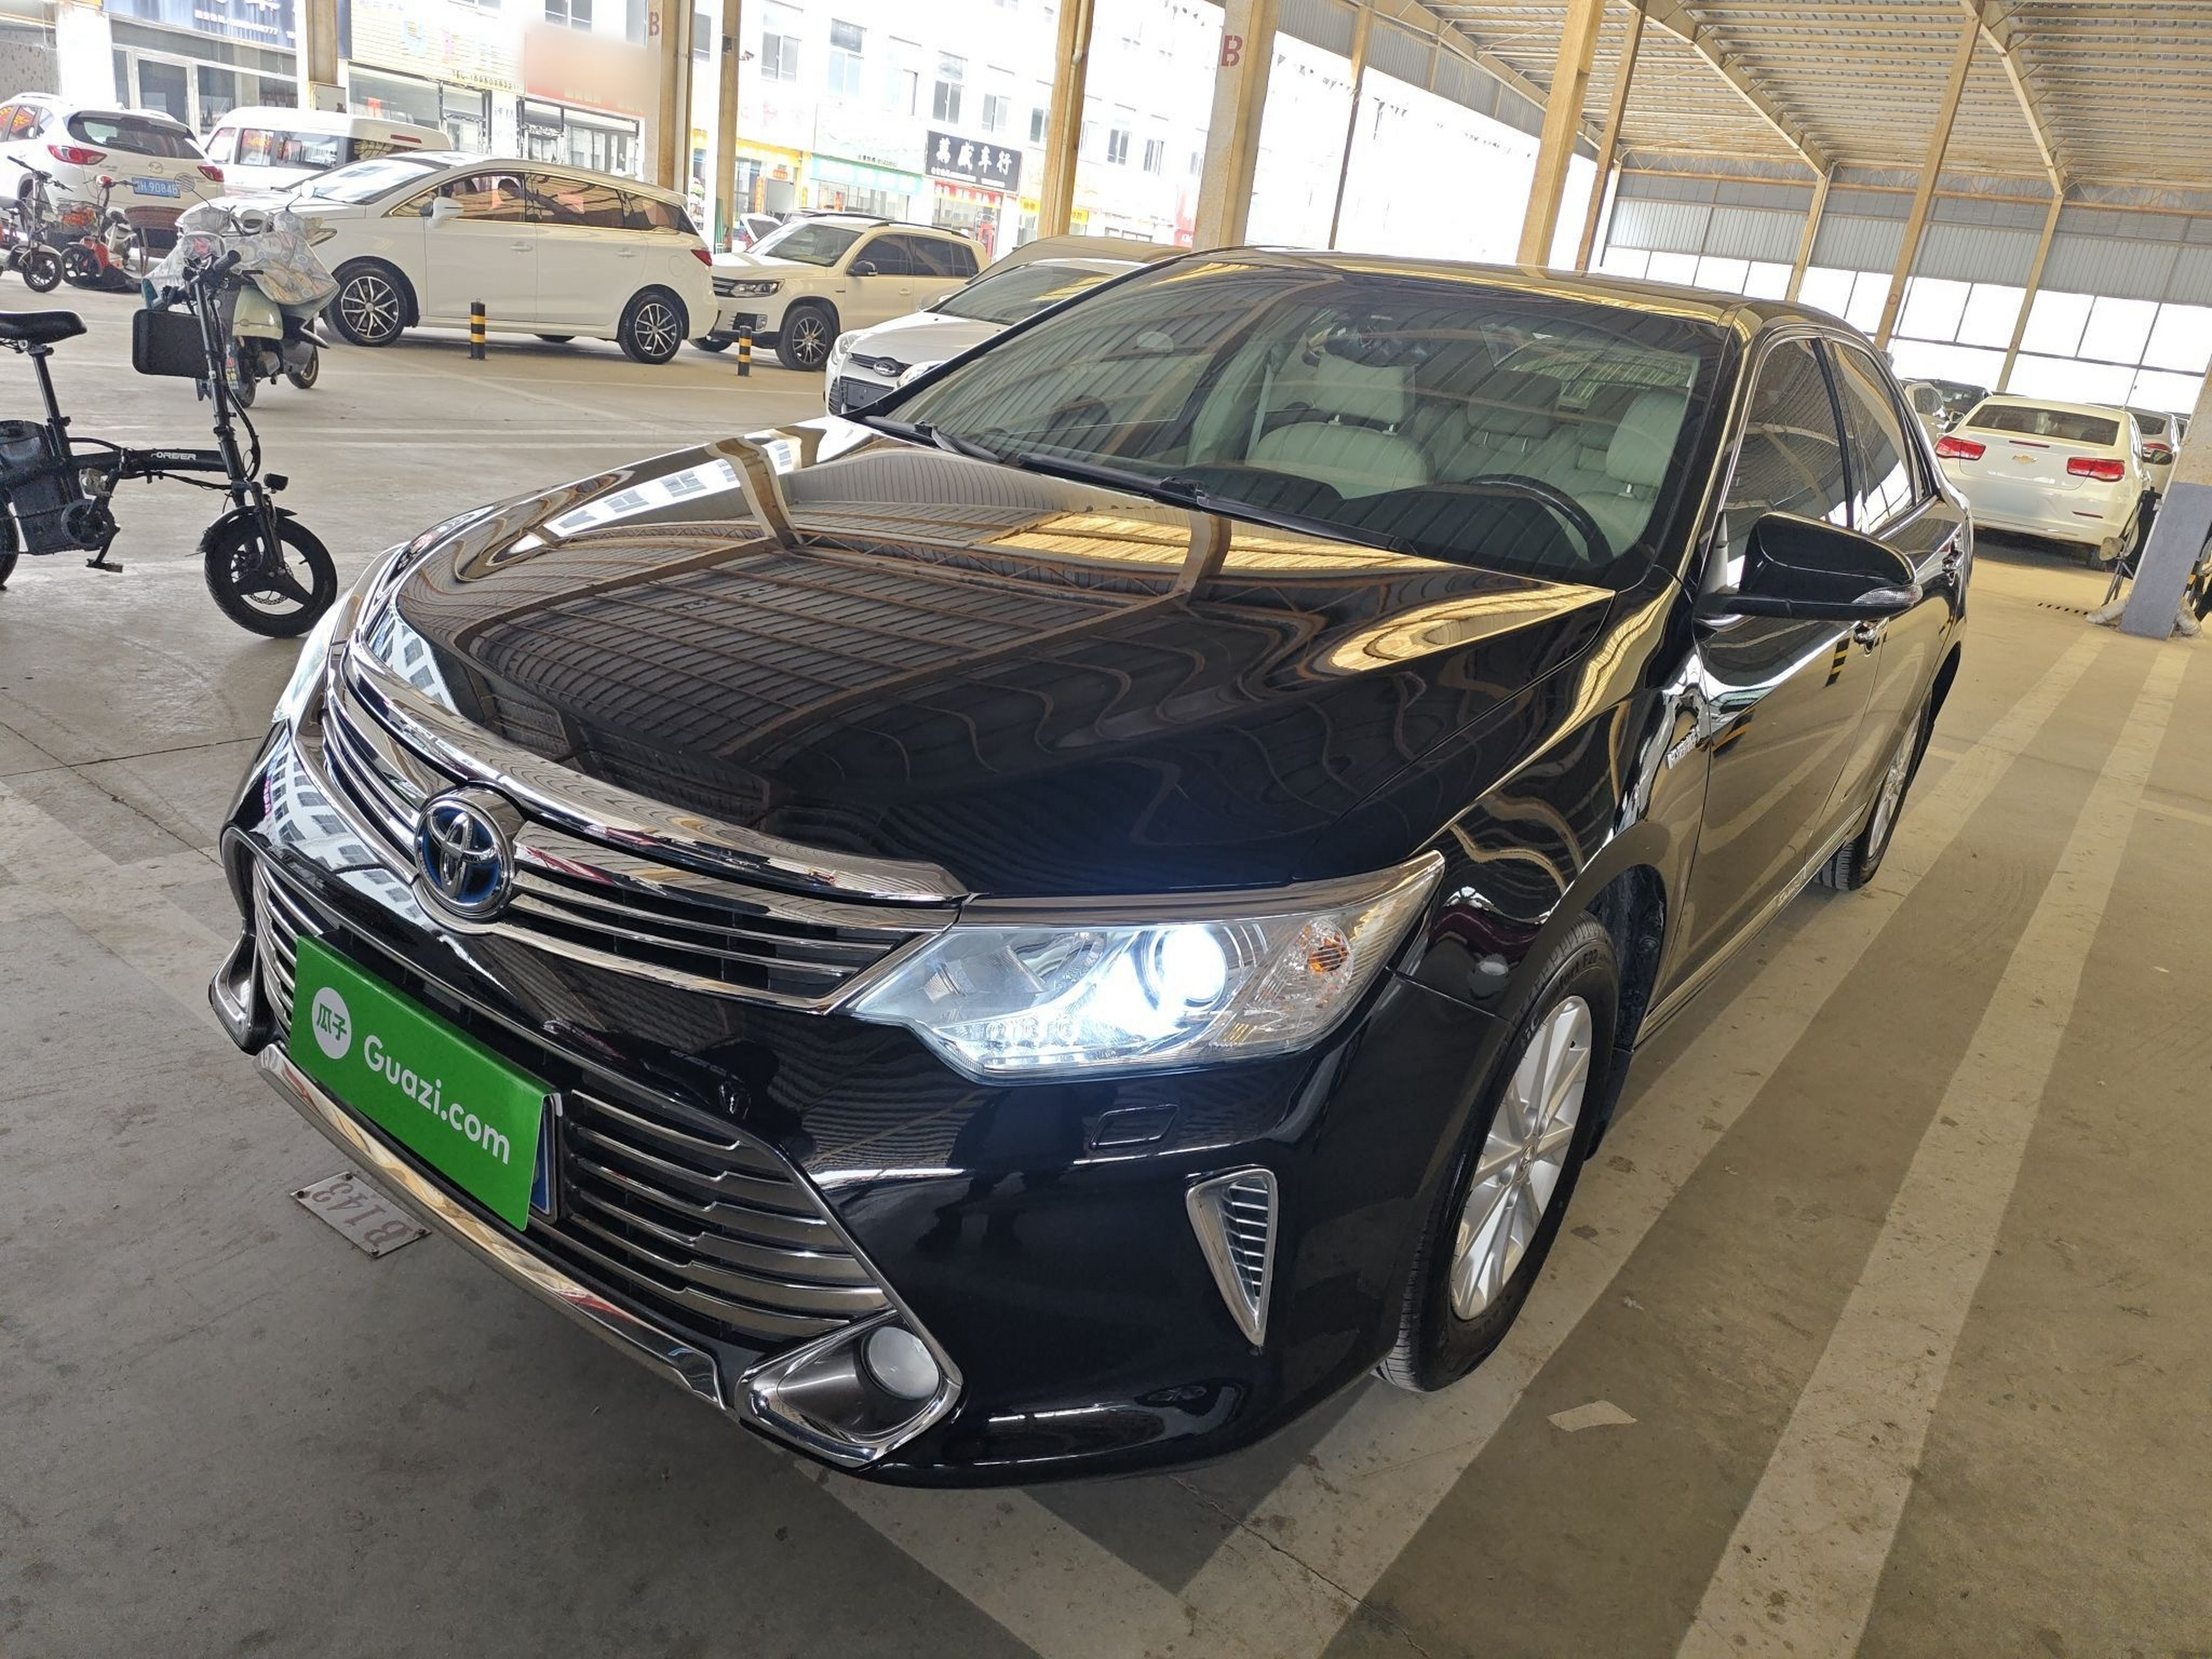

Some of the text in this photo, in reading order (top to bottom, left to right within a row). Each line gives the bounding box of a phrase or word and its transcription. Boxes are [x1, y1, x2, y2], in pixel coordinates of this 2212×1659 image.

[649, 12, 660, 36] B
[1222, 35, 1243, 66] B
[316, 1002, 347, 1041] 瓜子
[363, 1035, 510, 1165] Guazi.com
[312, 1182, 414, 1247] B143
